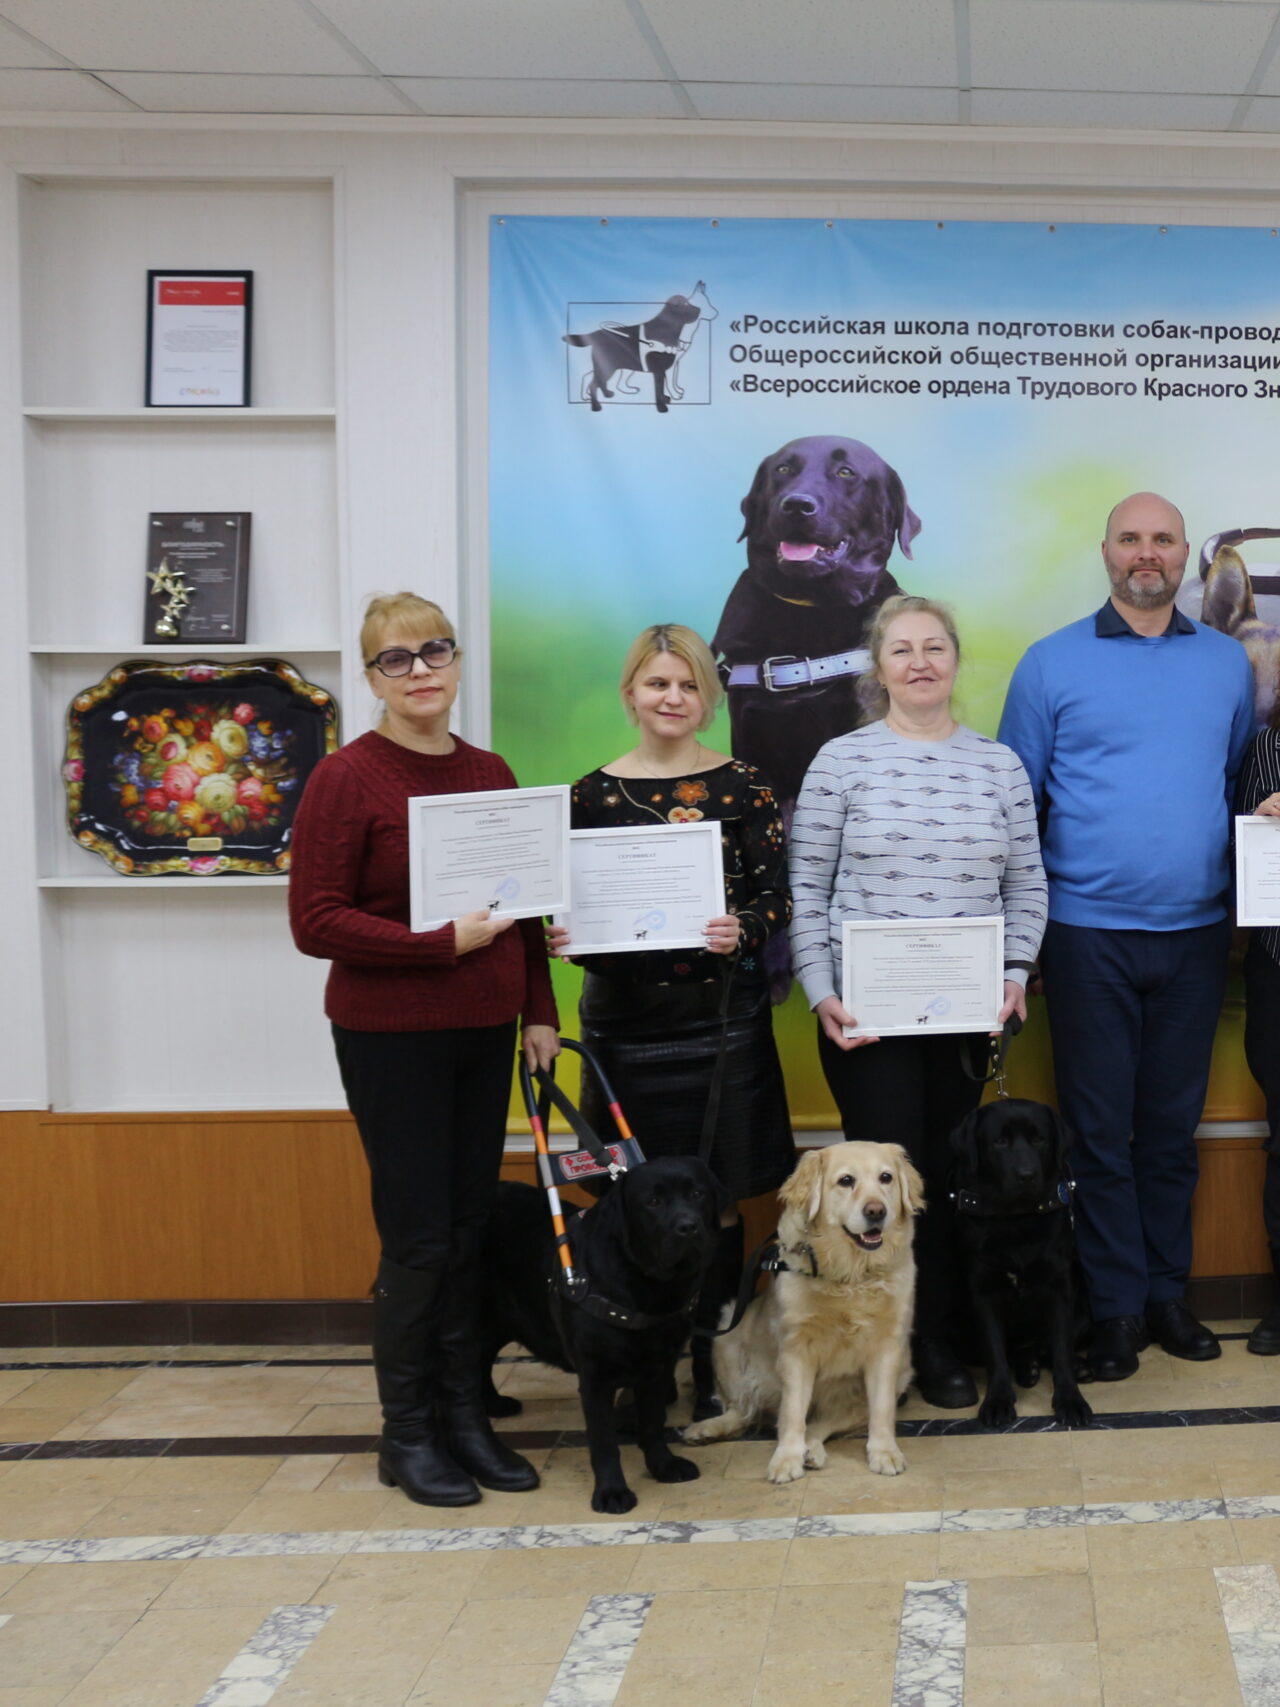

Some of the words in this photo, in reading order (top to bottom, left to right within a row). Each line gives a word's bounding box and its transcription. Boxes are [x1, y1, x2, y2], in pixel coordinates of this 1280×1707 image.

[729, 315, 886, 335] «Российская
[893, 320, 970, 336] школа
[977, 321, 1115, 341] подготовки
[729, 343, 942, 369] Общероссийской
[949, 345, 1127, 369] общественной
[729, 373, 922, 398] «Всероссийское
[927, 379, 1011, 400] ордена
[1016, 375, 1138, 401] Трудового
[1143, 377, 1249, 402] Красного
